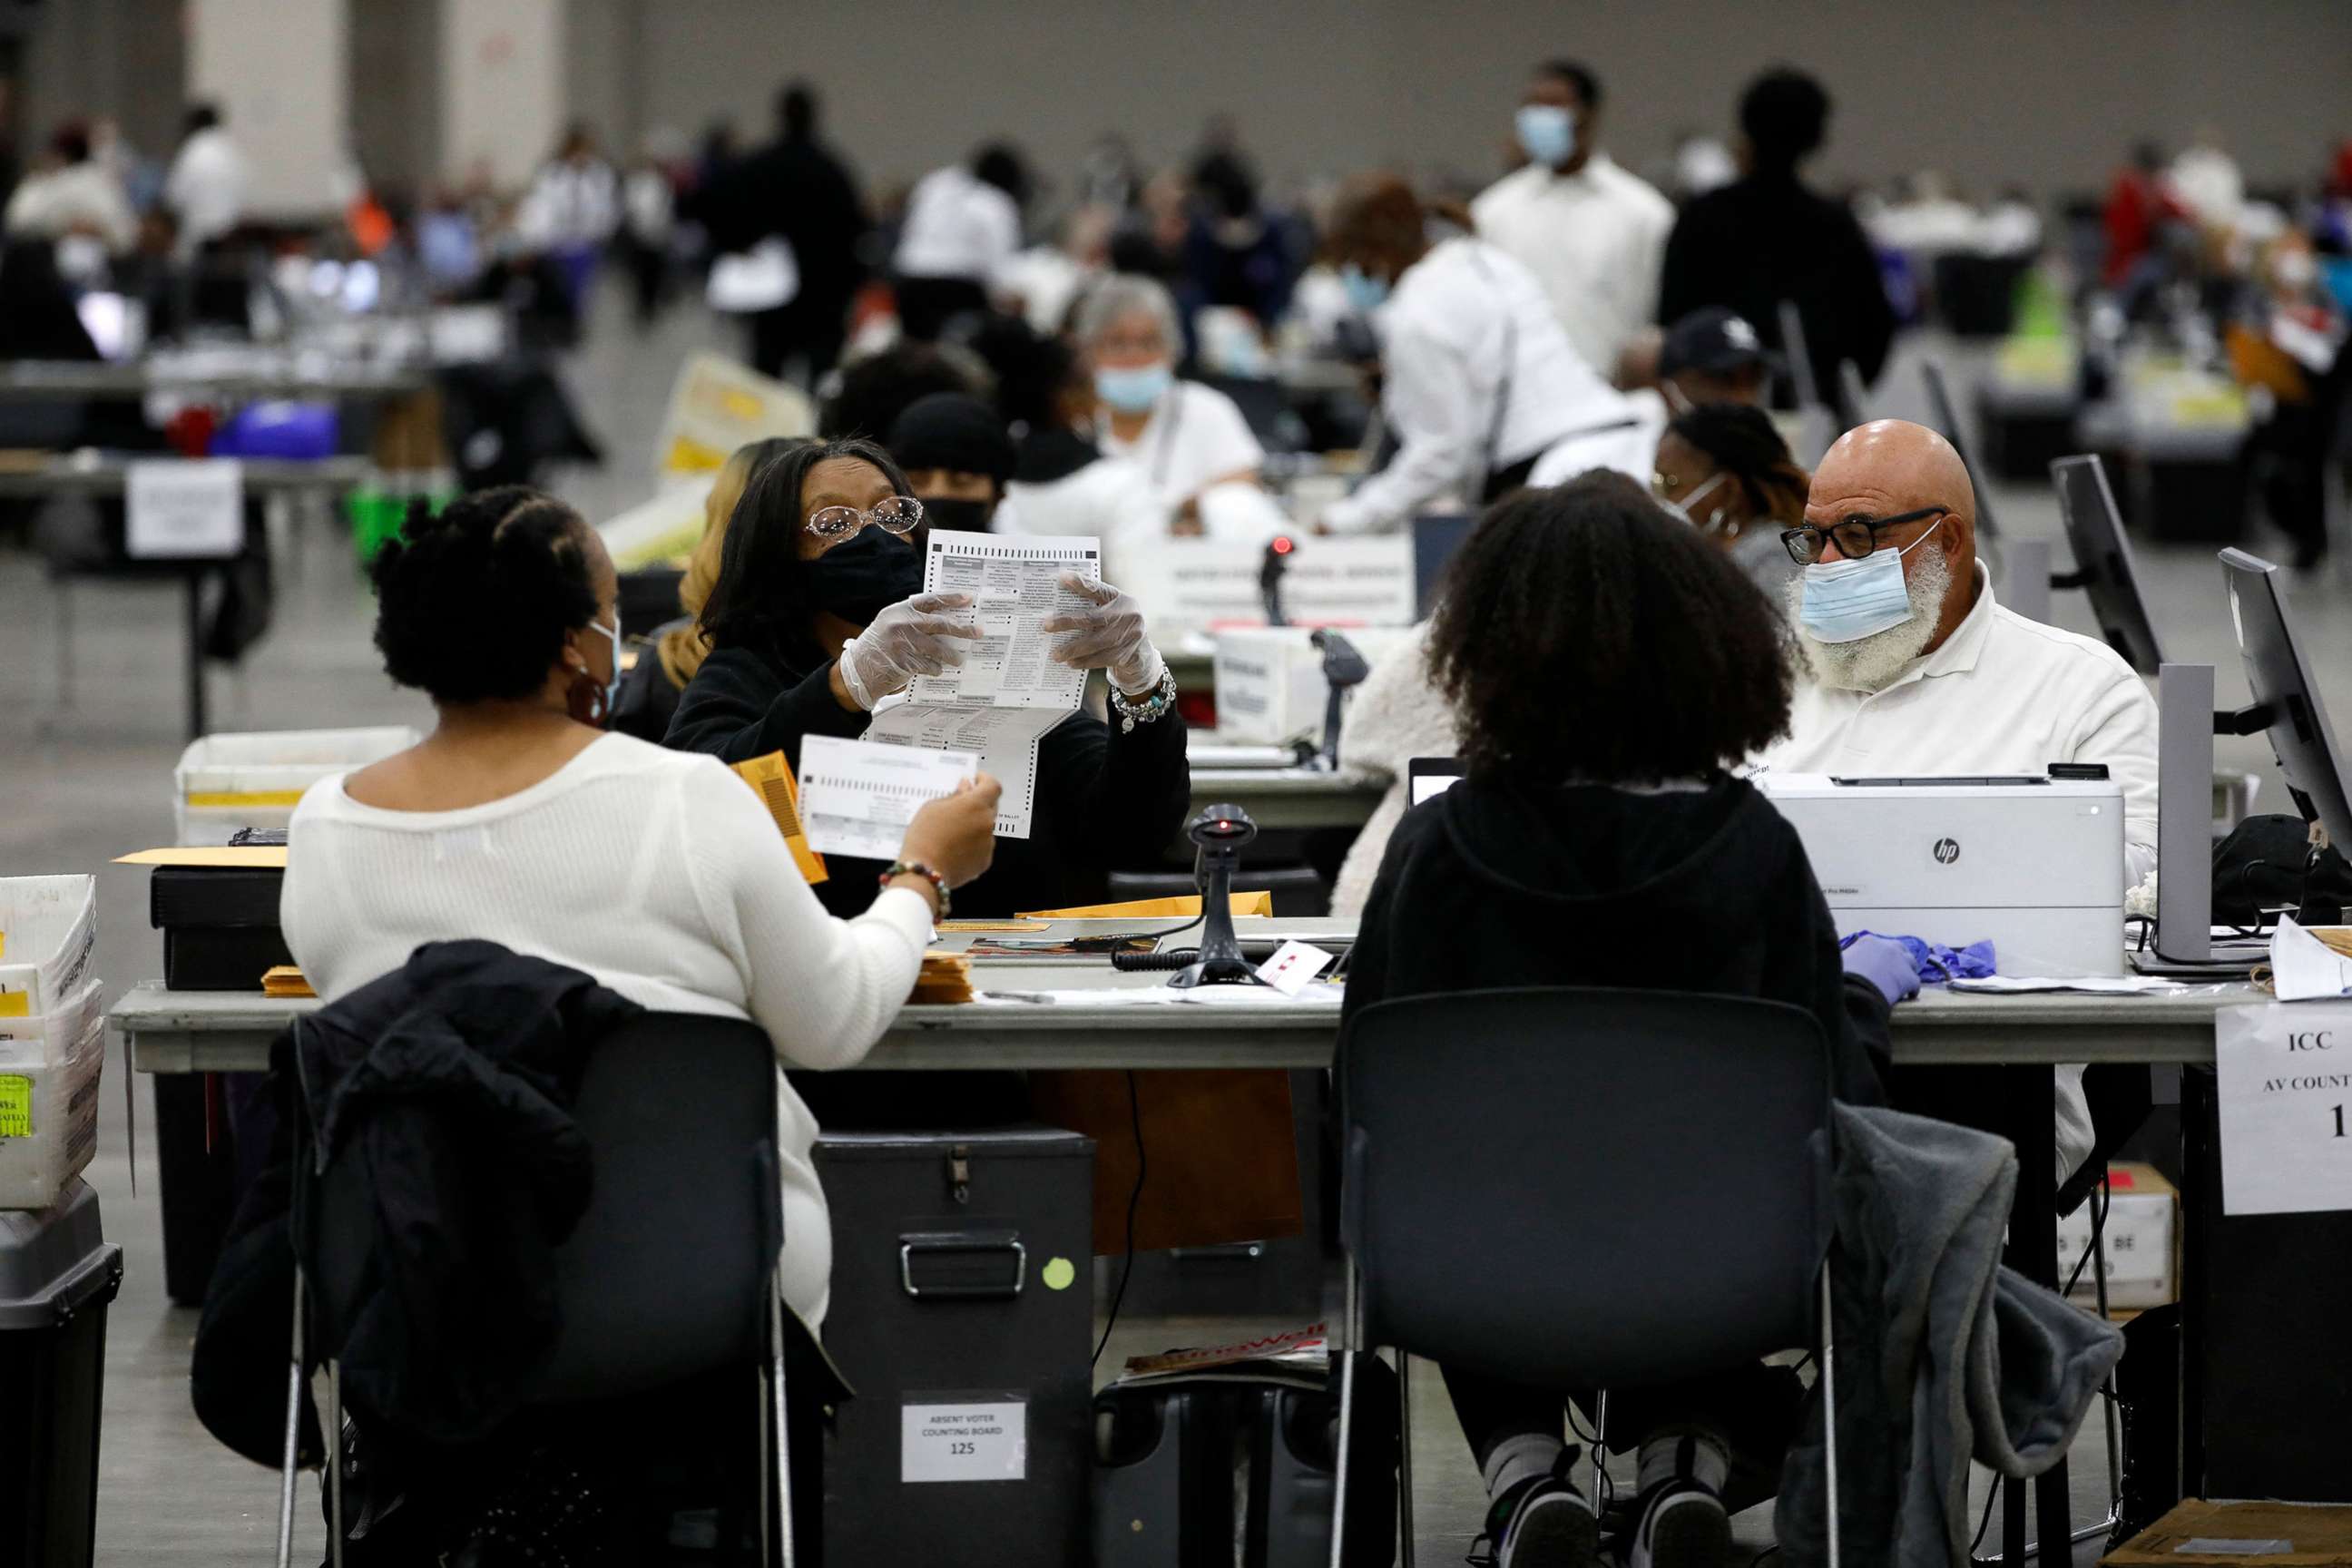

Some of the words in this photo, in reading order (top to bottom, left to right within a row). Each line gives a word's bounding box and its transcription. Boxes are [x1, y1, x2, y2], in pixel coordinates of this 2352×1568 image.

[1935, 838, 1960, 864] hp
[2288, 1031, 2332, 1052] ICC
[2263, 1078, 2288, 1092] AV
[2291, 1074, 2352, 1091] COUNT
[929, 1416, 964, 1424] ABSENT
[966, 1414, 995, 1423] VOTER
[922, 1428, 969, 1436] COUNTING
[972, 1427, 1003, 1436] BOARD
[951, 1442, 975, 1455] 125
